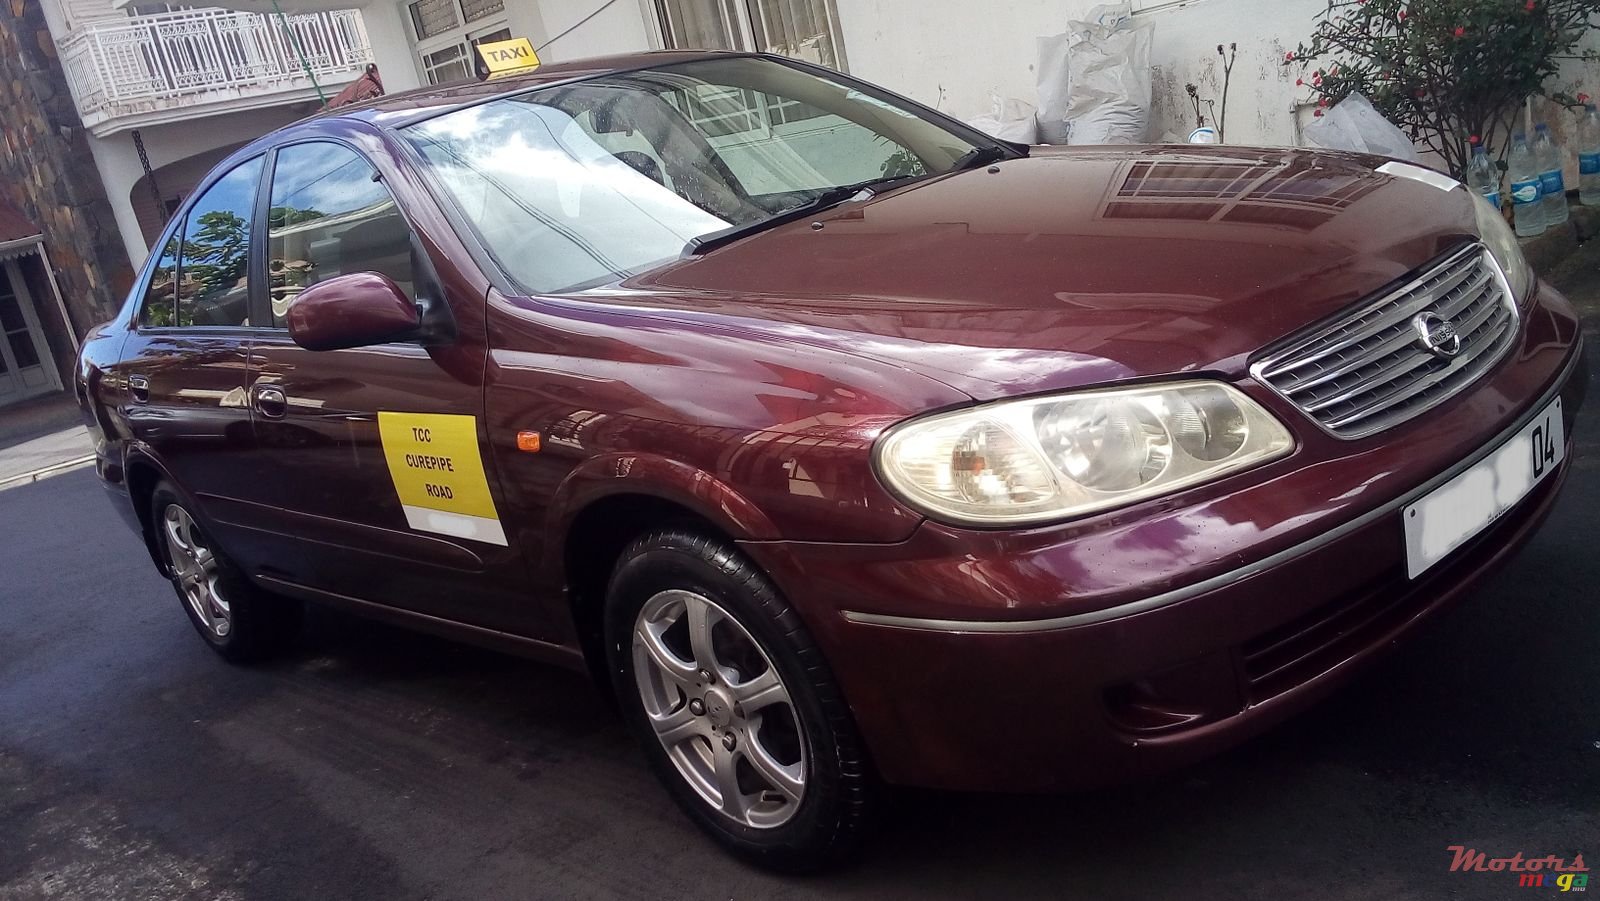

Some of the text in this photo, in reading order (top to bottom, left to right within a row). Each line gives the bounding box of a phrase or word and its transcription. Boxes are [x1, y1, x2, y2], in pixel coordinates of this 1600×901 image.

[487, 46, 529, 62] TAXI
[412, 428, 431, 443] TCC
[1532, 416, 1555, 479] 04
[406, 454, 454, 472] CUREPIPE
[425, 484, 453, 499] ROAD
